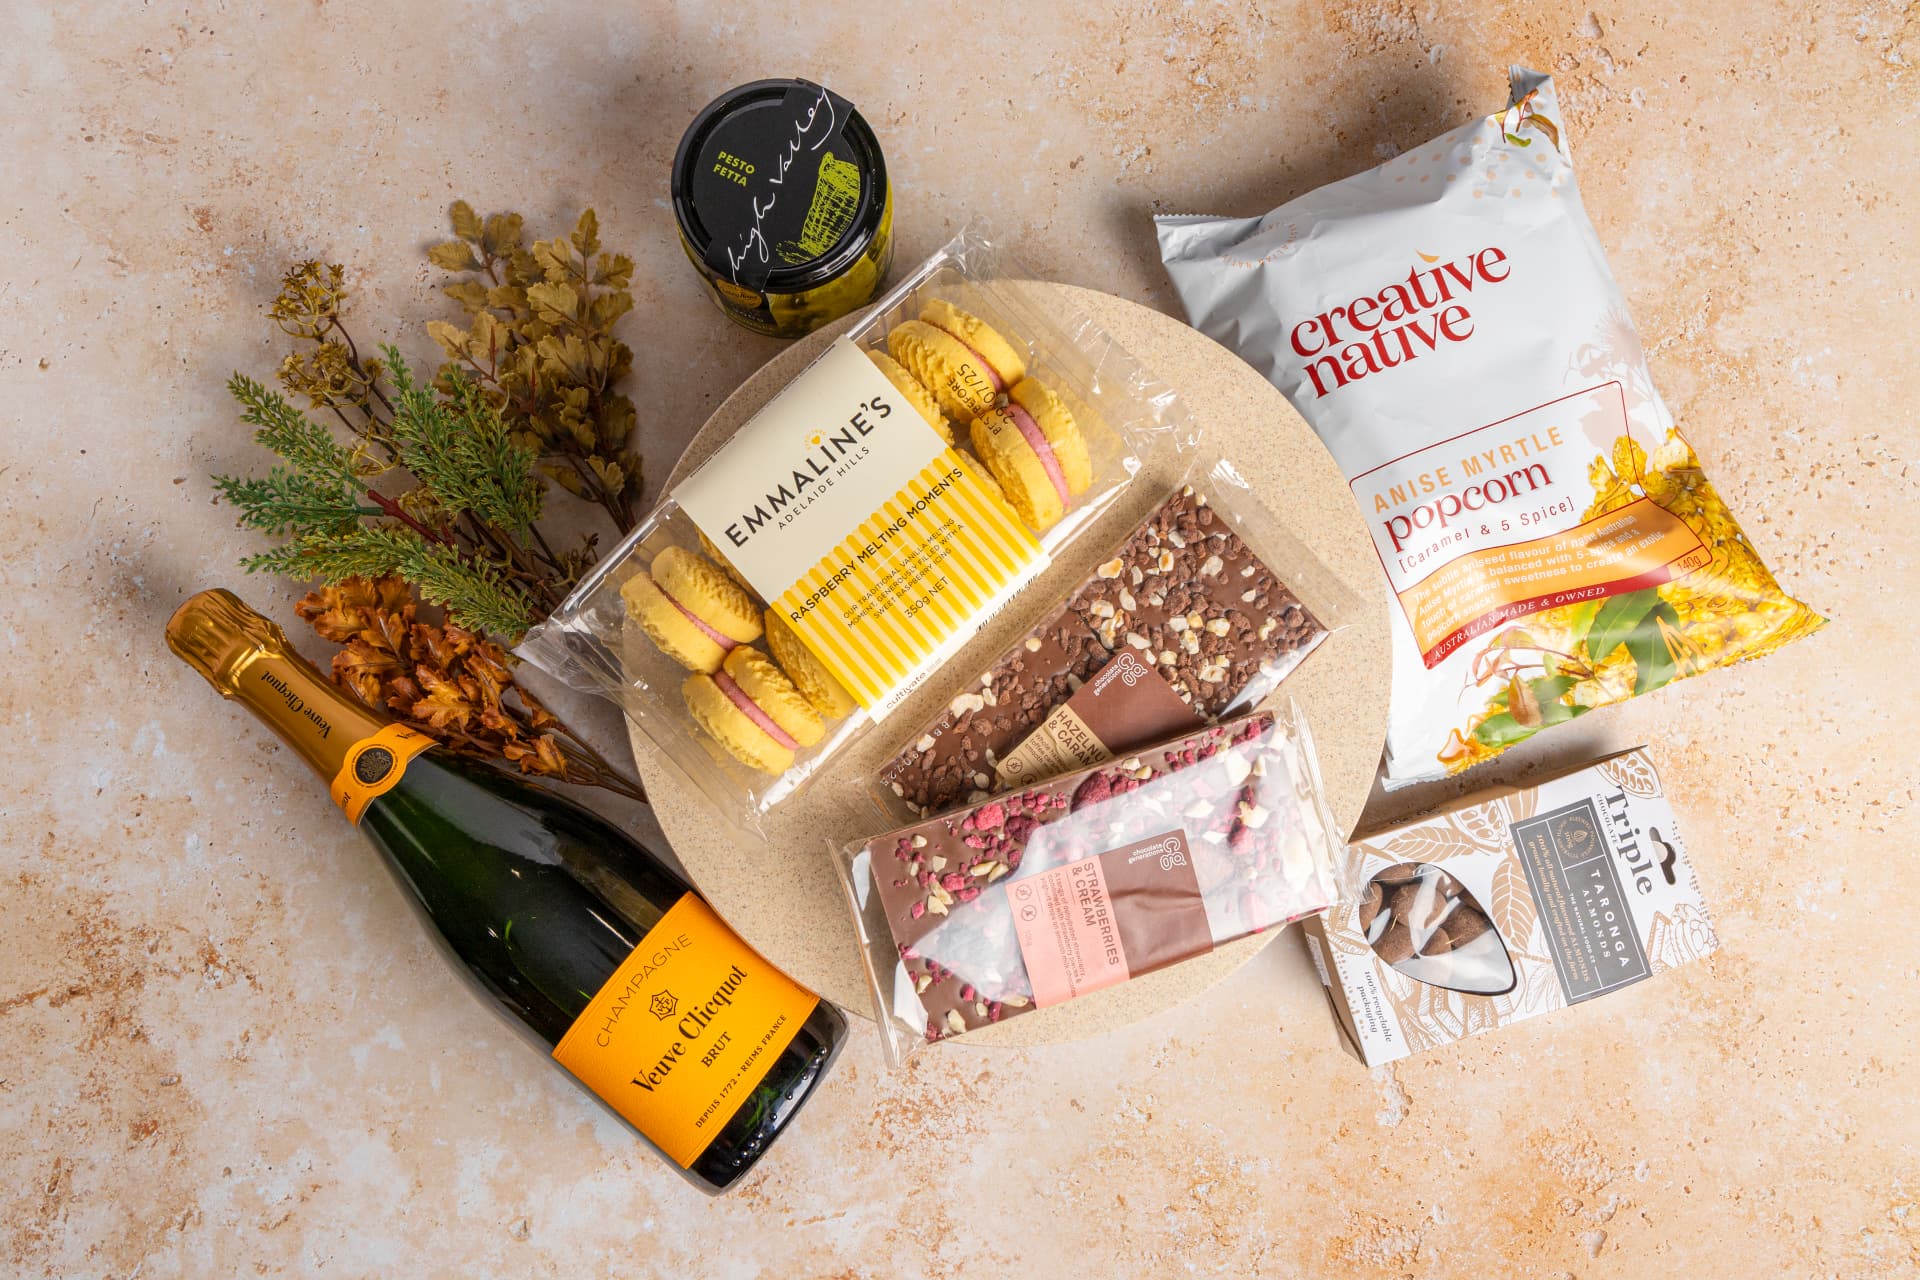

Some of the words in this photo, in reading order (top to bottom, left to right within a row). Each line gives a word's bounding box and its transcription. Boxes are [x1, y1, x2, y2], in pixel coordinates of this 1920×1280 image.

[712, 163, 748, 187] FETTA
[718, 151, 755, 174] PESTO
[1291, 246, 1511, 357] creative
[1303, 305, 1475, 400] native
[947, 378, 980, 413] BEFORE
[957, 363, 1015, 424] 2907/25
[724, 395, 893, 547] EMMALINE'S
[777, 478, 834, 530] ADELAIDE
[837, 446, 869, 477] HILLS
[1372, 466, 1451, 515] ANISE
[1461, 425, 1565, 483] MYRTLE
[1381, 460, 1553, 554] popcorn
[1480, 523, 1492, 536] &
[1500, 519, 1511, 533] 5
[790, 560, 858, 623] RASPBERRY
[857, 516, 907, 563] MELTING
[907, 467, 963, 519] MOMENTS
[842, 605, 858, 618] OUR
[858, 567, 899, 605] TRADITIONAL
[900, 542, 927, 567] VANILLA
[927, 518, 954, 543] MELTING
[877, 564, 918, 602] GENEROUSLY
[918, 544, 940, 565] FILLED
[939, 529, 957, 545] WITH
[1419, 596, 1441, 616] Anise
[1489, 558, 1542, 577] balanced
[1546, 553, 1572, 566] with
[1616, 531, 1632, 543] and
[1432, 570, 1458, 589] subtle
[1462, 553, 1506, 574] aniseed
[1509, 545, 1551, 561] flavour
[1554, 541, 1568, 552] of
[1676, 553, 1702, 572] 140g
[873, 597, 896, 619] SWEET
[896, 563, 933, 598] RASPBERRY
[933, 547, 951, 565] ICING
[904, 595, 930, 618] 350g
[928, 576, 949, 596] NET
[1422, 607, 1446, 627] touch
[1446, 599, 1458, 610] of
[1503, 566, 1567, 585] sweetness
[1569, 562, 1582, 572] to
[1586, 552, 1624, 569] create
[1625, 544, 1638, 556] an
[1434, 617, 1497, 659] AUSTRALIAN
[1498, 601, 1536, 619] MADE
[1540, 598, 1550, 607] &
[1554, 586, 1606, 603] OWNED
[260, 670, 305, 716] Clicquot
[303, 707, 332, 740] Veuve
[1048, 719, 1059, 730] &
[1056, 729, 1091, 763] CARAM
[1056, 711, 1105, 763] HAZELNU
[1596, 793, 1617, 843] CHOCOLATE
[1605, 785, 1654, 895] Triple
[1071, 866, 1083, 876] &
[1074, 879, 1096, 926] CREAM
[1055, 907, 1064, 921] with
[1083, 862, 1119, 965] STRAWBERRIES
[1535, 833, 1549, 858] 100%
[1547, 869, 1563, 899] natural
[1569, 936, 1589, 982] ALMONDS
[1573, 906, 1586, 934] NATURAL
[1583, 936, 1592, 953] FOOD
[1582, 889, 1611, 959] ALMONDS
[1590, 869, 1630, 967] TARONGA
[596, 933, 693, 1049] CHAMPAGNE
[1356, 985, 1378, 1034] packaging
[1364, 970, 1377, 995] 100%
[1372, 994, 1392, 1043] recyclable
[630, 1041, 687, 1095] Veuve
[677, 964, 749, 1040] Clicquot
[700, 1029, 733, 1068] BRUT
[695, 1099, 721, 1129] DEPUIS
[719, 1077, 739, 1100] 1772
[740, 1046, 763, 1073] REIMS
[761, 1014, 788, 1046] FRANCE
